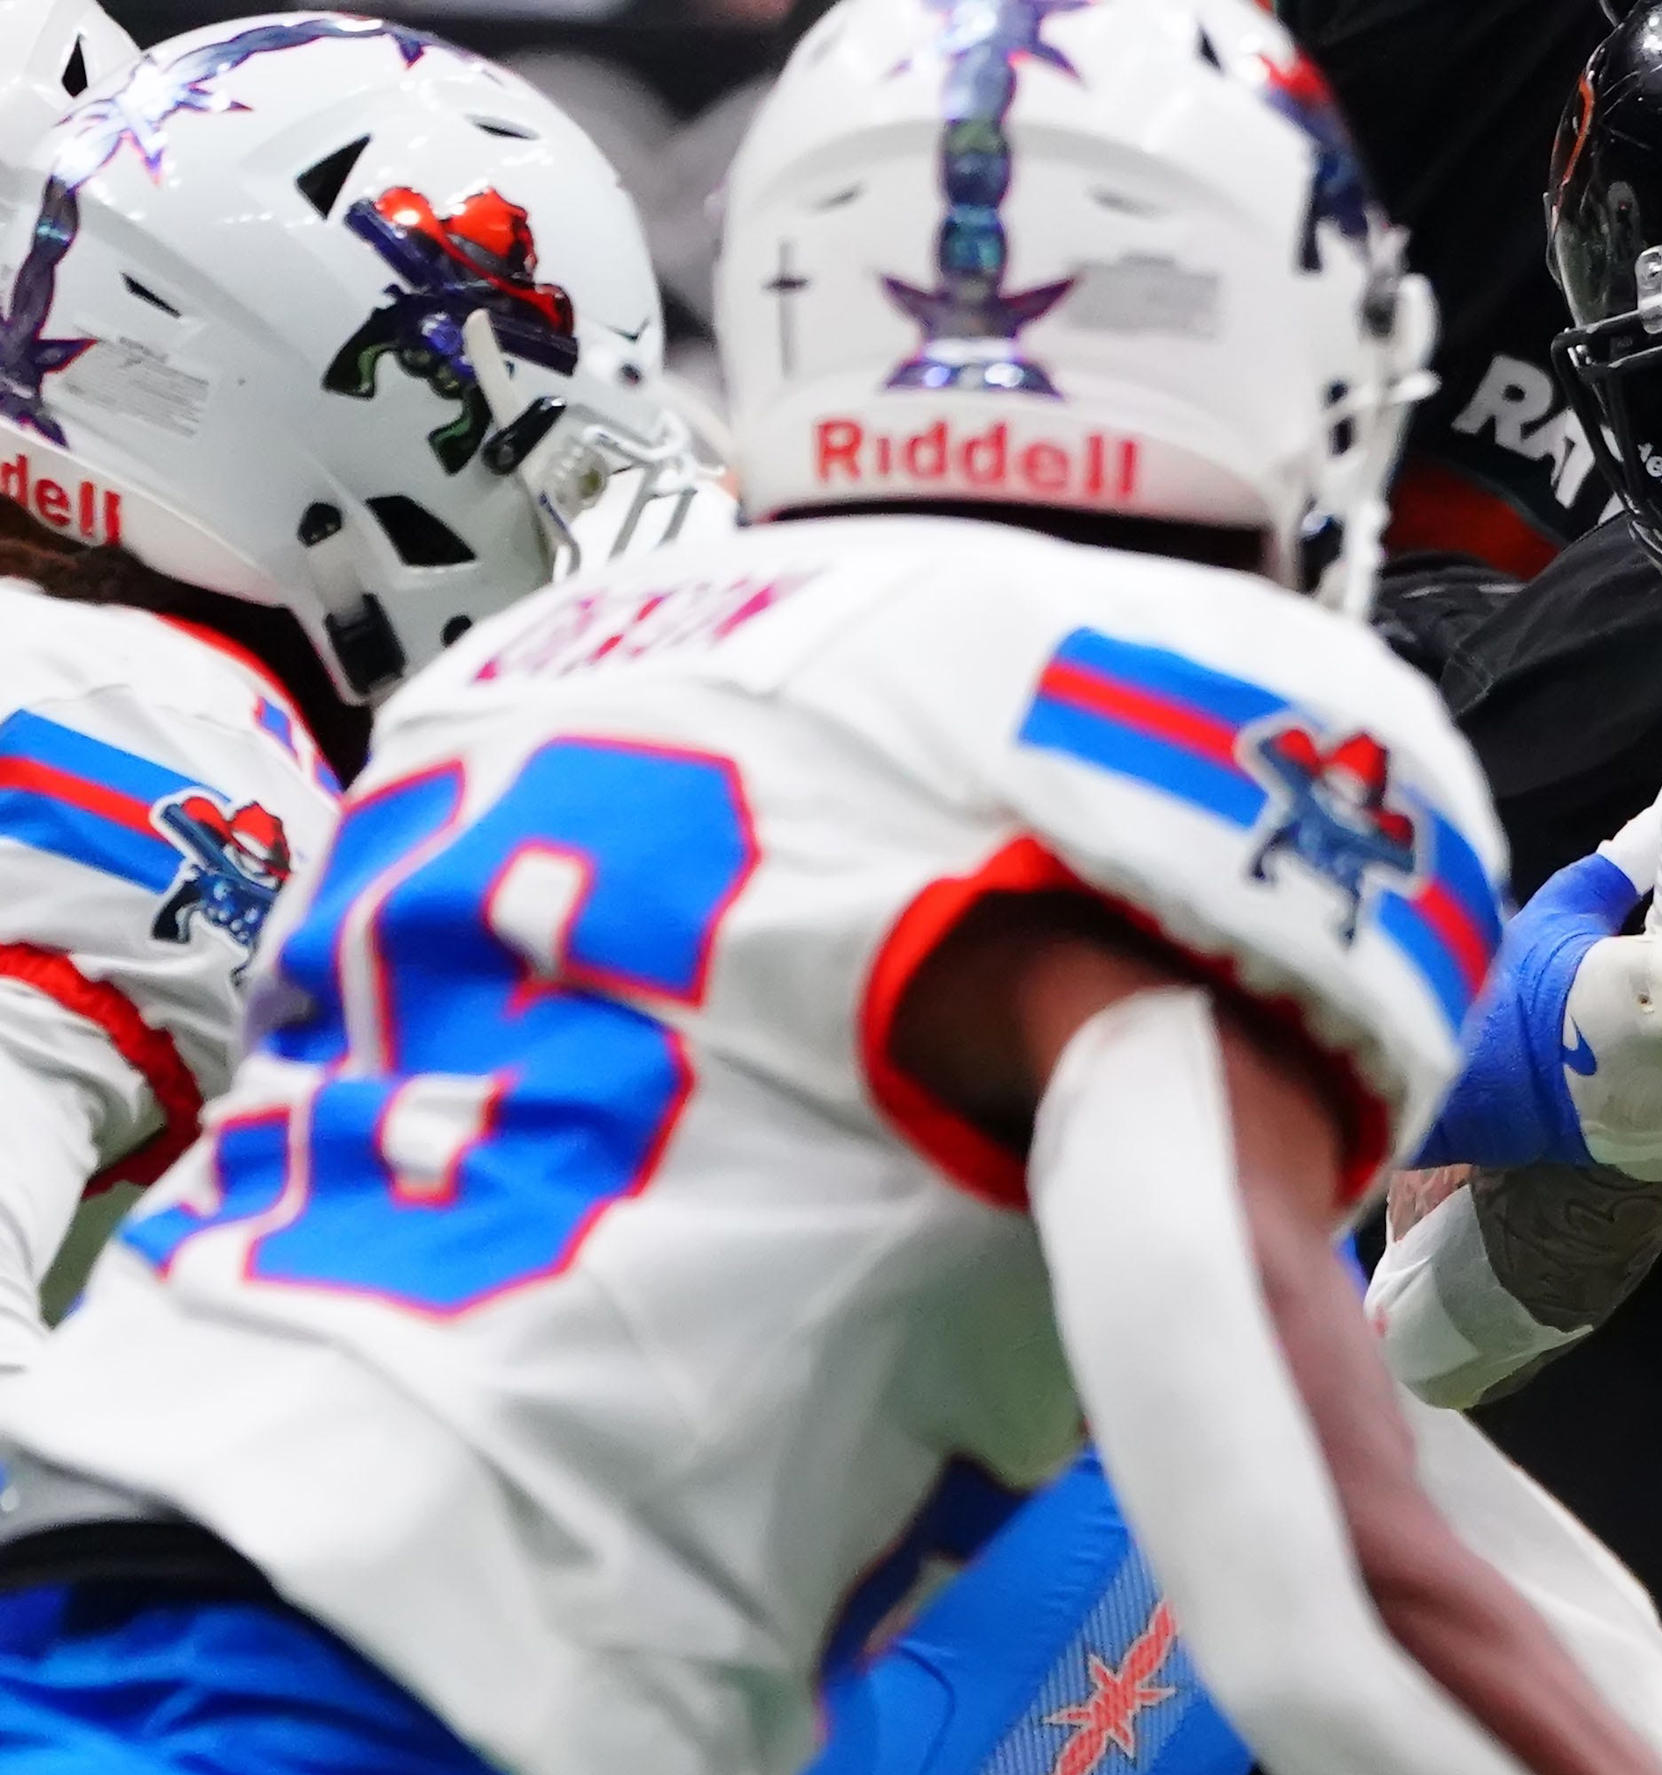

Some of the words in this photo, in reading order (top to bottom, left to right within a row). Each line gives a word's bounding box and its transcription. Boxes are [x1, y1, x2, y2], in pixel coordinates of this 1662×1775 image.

[814, 417, 1143, 498] Riddell
[1451, 353, 1596, 510] RA
[0, 452, 123, 547] dell
